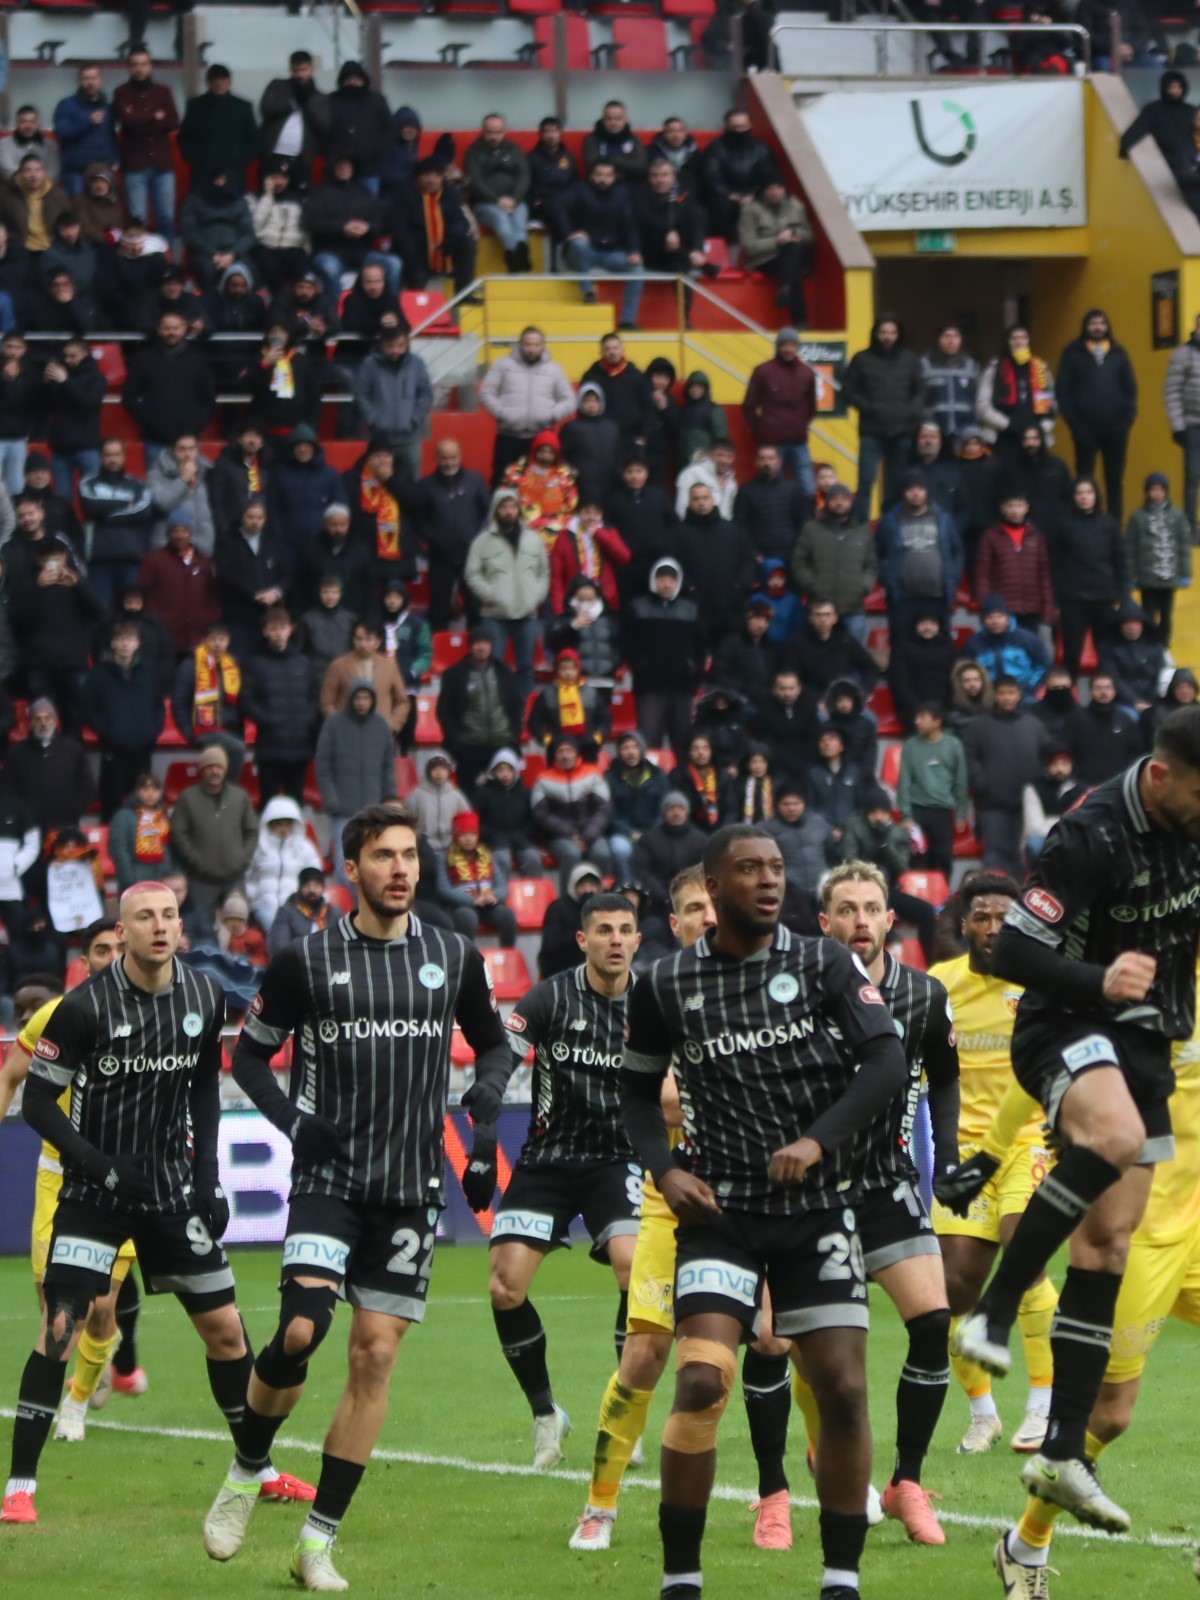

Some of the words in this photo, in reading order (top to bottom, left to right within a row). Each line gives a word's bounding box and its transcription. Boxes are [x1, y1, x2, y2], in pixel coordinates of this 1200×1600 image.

[1029, 891, 1058, 918] Torku
[341, 1017, 444, 1040] TÜMOSAN
[703, 1016, 815, 1059] TÜMOSAN
[122, 1052, 200, 1074] TÜMOSAN
[572, 1047, 624, 1069] TÜMO
[386, 1227, 435, 1279] 22
[817, 1231, 866, 1282] 20
[678, 1267, 756, 1298] onvo
